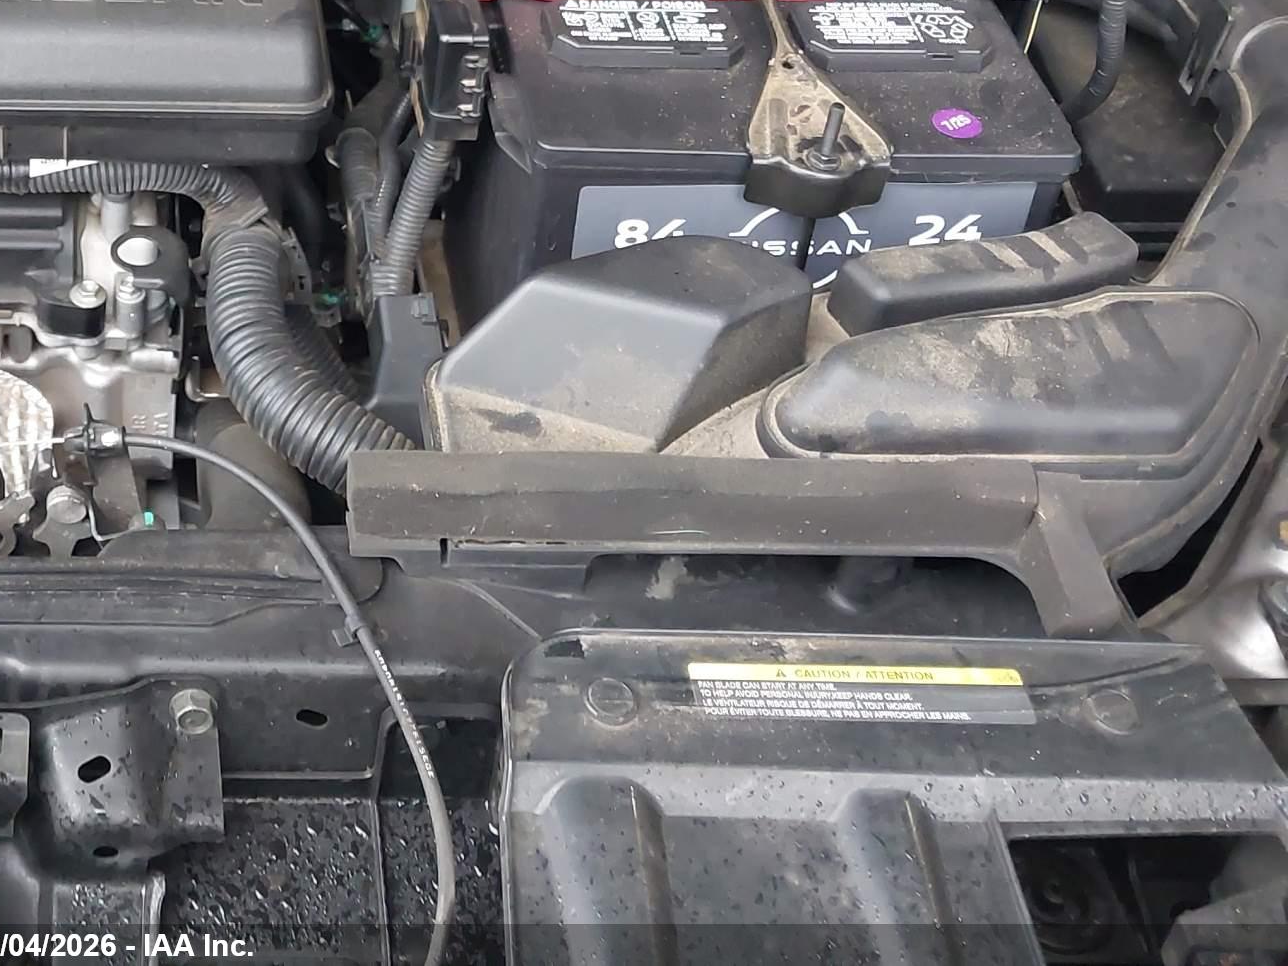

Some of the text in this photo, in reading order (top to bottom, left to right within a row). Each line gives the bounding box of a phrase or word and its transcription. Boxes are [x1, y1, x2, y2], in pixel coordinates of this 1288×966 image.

[579, 0, 638, 10] DANGER
[652, 1, 706, 11] POISON
[908, 213, 982, 247] 24
[794, 668, 851, 679] CAUTION
[864, 670, 934, 681] ATTENTION
[698, 681, 714, 689] FAN
[714, 681, 741, 689] BLADE
[742, 682, 760, 690] CAN
[761, 682, 786, 690] START
[787, 682, 796, 690] AT
[798, 682, 815, 690] ANY
[713, 690, 733, 698] HELP
[735, 690, 759, 698] AVOID
[760, 690, 803, 699] PERSONAL
[854, 692, 883, 700] HANDS
[703, 699, 713, 707] LE
[714, 699, 766, 708] VENTILATEUR
[767, 700, 797, 709] RISQUE
[798, 701, 811, 709] DE
[864, 702, 885, 710] TOUT
[705, 707, 729, 715] POUR
[875, 711, 925, 720] APPROCHER
